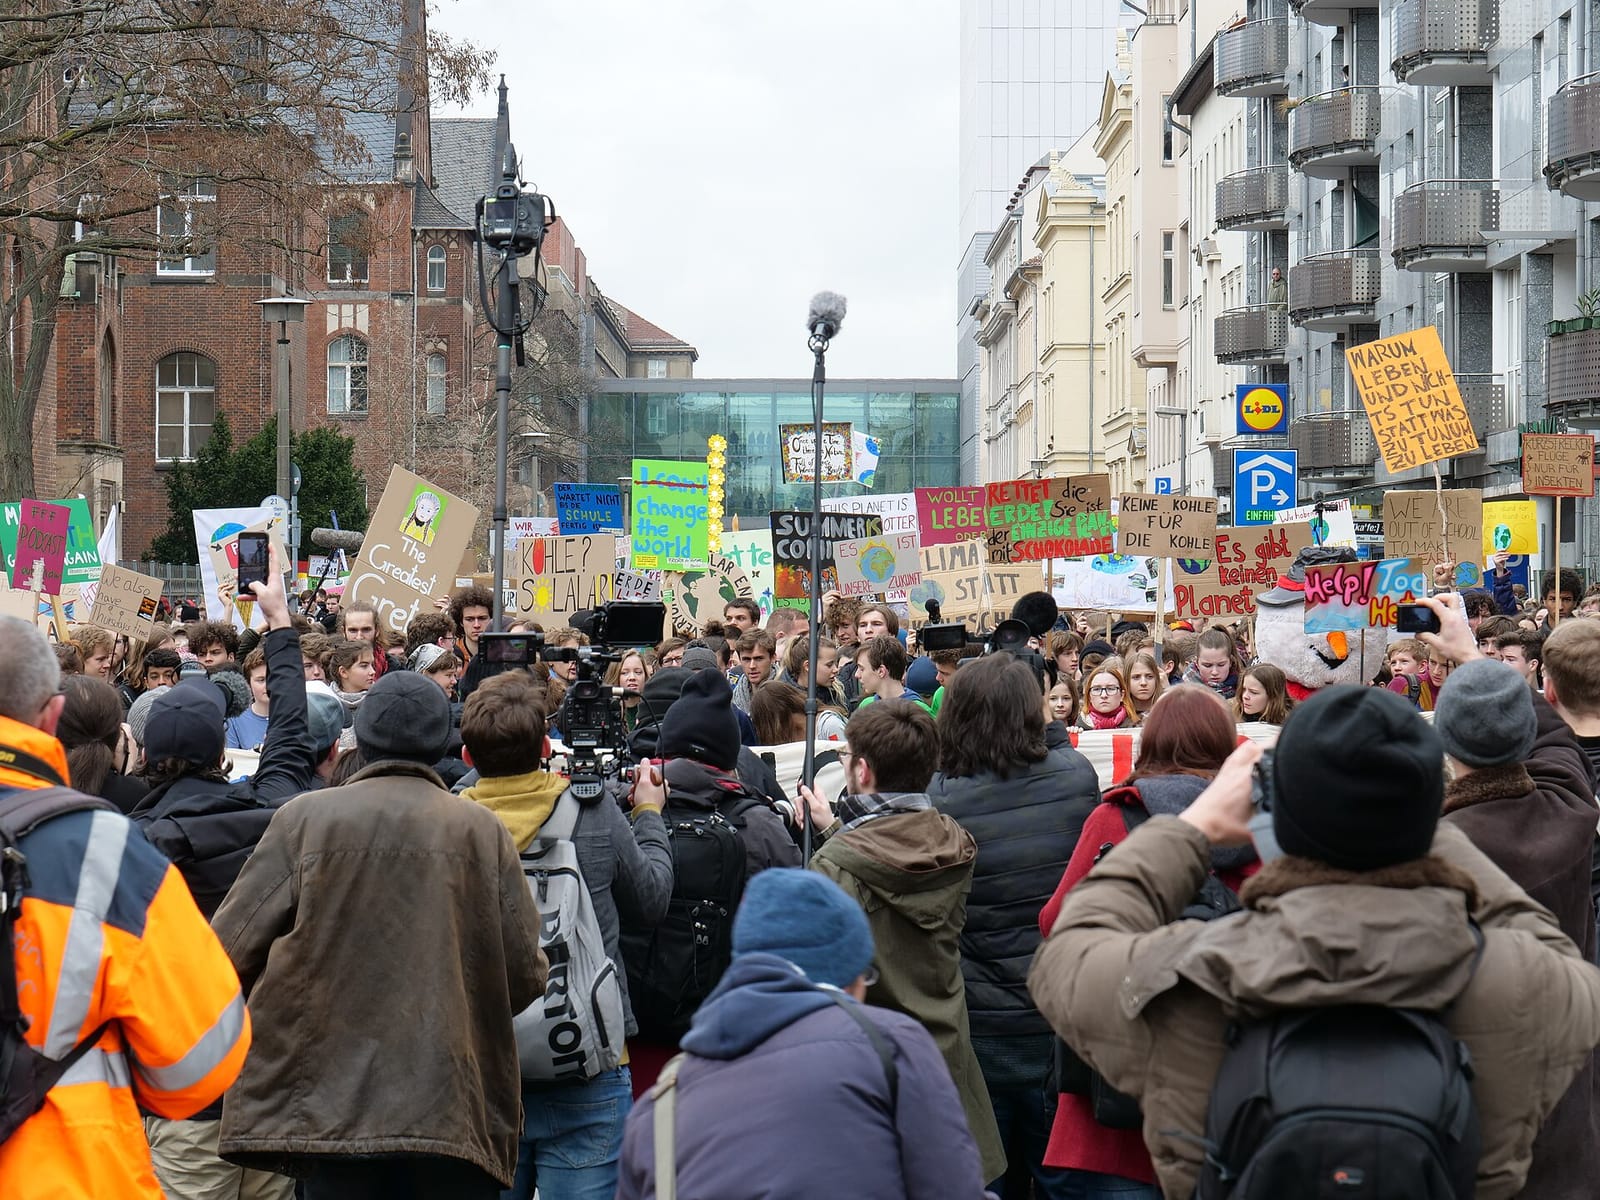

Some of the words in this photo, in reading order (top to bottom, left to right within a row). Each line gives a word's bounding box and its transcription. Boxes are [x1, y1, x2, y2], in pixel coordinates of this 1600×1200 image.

[1350, 337, 1418, 369] WARUM
[1360, 357, 1430, 390] LEBEN
[1365, 383, 1408, 405] UND
[1370, 405, 1396, 426] TS
[1400, 390, 1452, 416] TUN
[1420, 435, 1475, 461] LEBEN
[1534, 463, 1555, 474] NUR
[988, 478, 1051, 506] RETTET
[1062, 477, 1086, 502] die
[1251, 470, 1276, 506] P
[1535, 476, 1583, 488] INSEKTEN
[558, 493, 590, 502] WARTET
[596, 494, 620, 506] NICHT
[852, 499, 895, 514] PLANET
[897, 498, 908, 511] IS
[927, 490, 979, 504] WOLLT
[1122, 496, 1159, 512] KEINE
[1172, 498, 1215, 513] KOHLE
[1389, 497, 1424, 519] WE
[565, 509, 612, 522] SCHULE
[636, 495, 708, 528] change
[989, 499, 1054, 527] ERDE!
[1050, 500, 1076, 518] Sie
[1086, 497, 1104, 513] ist
[1147, 511, 1183, 529] FÜR
[1246, 511, 1276, 521] EINFAH
[515, 521, 533, 531] WIR
[636, 517, 669, 538] the
[881, 515, 916, 532] OTTER
[1388, 521, 1419, 538] OUT
[1422, 521, 1437, 539] OF
[1440, 521, 1480, 540] CHOOL
[20, 523, 65, 556] PODCAST
[633, 535, 691, 559] world
[839, 543, 858, 558] ES
[897, 535, 917, 549] IST
[987, 528, 1010, 546] der
[1126, 533, 1152, 547] DIE
[1169, 534, 1210, 549] KOHLE
[1215, 534, 1246, 564] Es
[1255, 527, 1291, 569] gibt
[1388, 541, 1410, 554] TO
[401, 536, 426, 564] The
[922, 542, 988, 572] LIMA
[992, 543, 1012, 563] mit
[1010, 536, 1114, 563] SCHOKOLADE
[369, 544, 437, 596] Greatest
[708, 553, 735, 575] LAR
[102, 567, 121, 588] We
[123, 577, 151, 596] also
[615, 572, 653, 595] ERDE
[839, 580, 874, 597] UNSERE
[888, 572, 922, 589] ZUKUNFT
[1218, 565, 1278, 586] keinen
[1304, 561, 1377, 606] Help!
[97, 586, 122, 606] have
[352, 573, 420, 634] Gret
[1173, 585, 1257, 618] Planet
[0, 751, 16, 763] on
